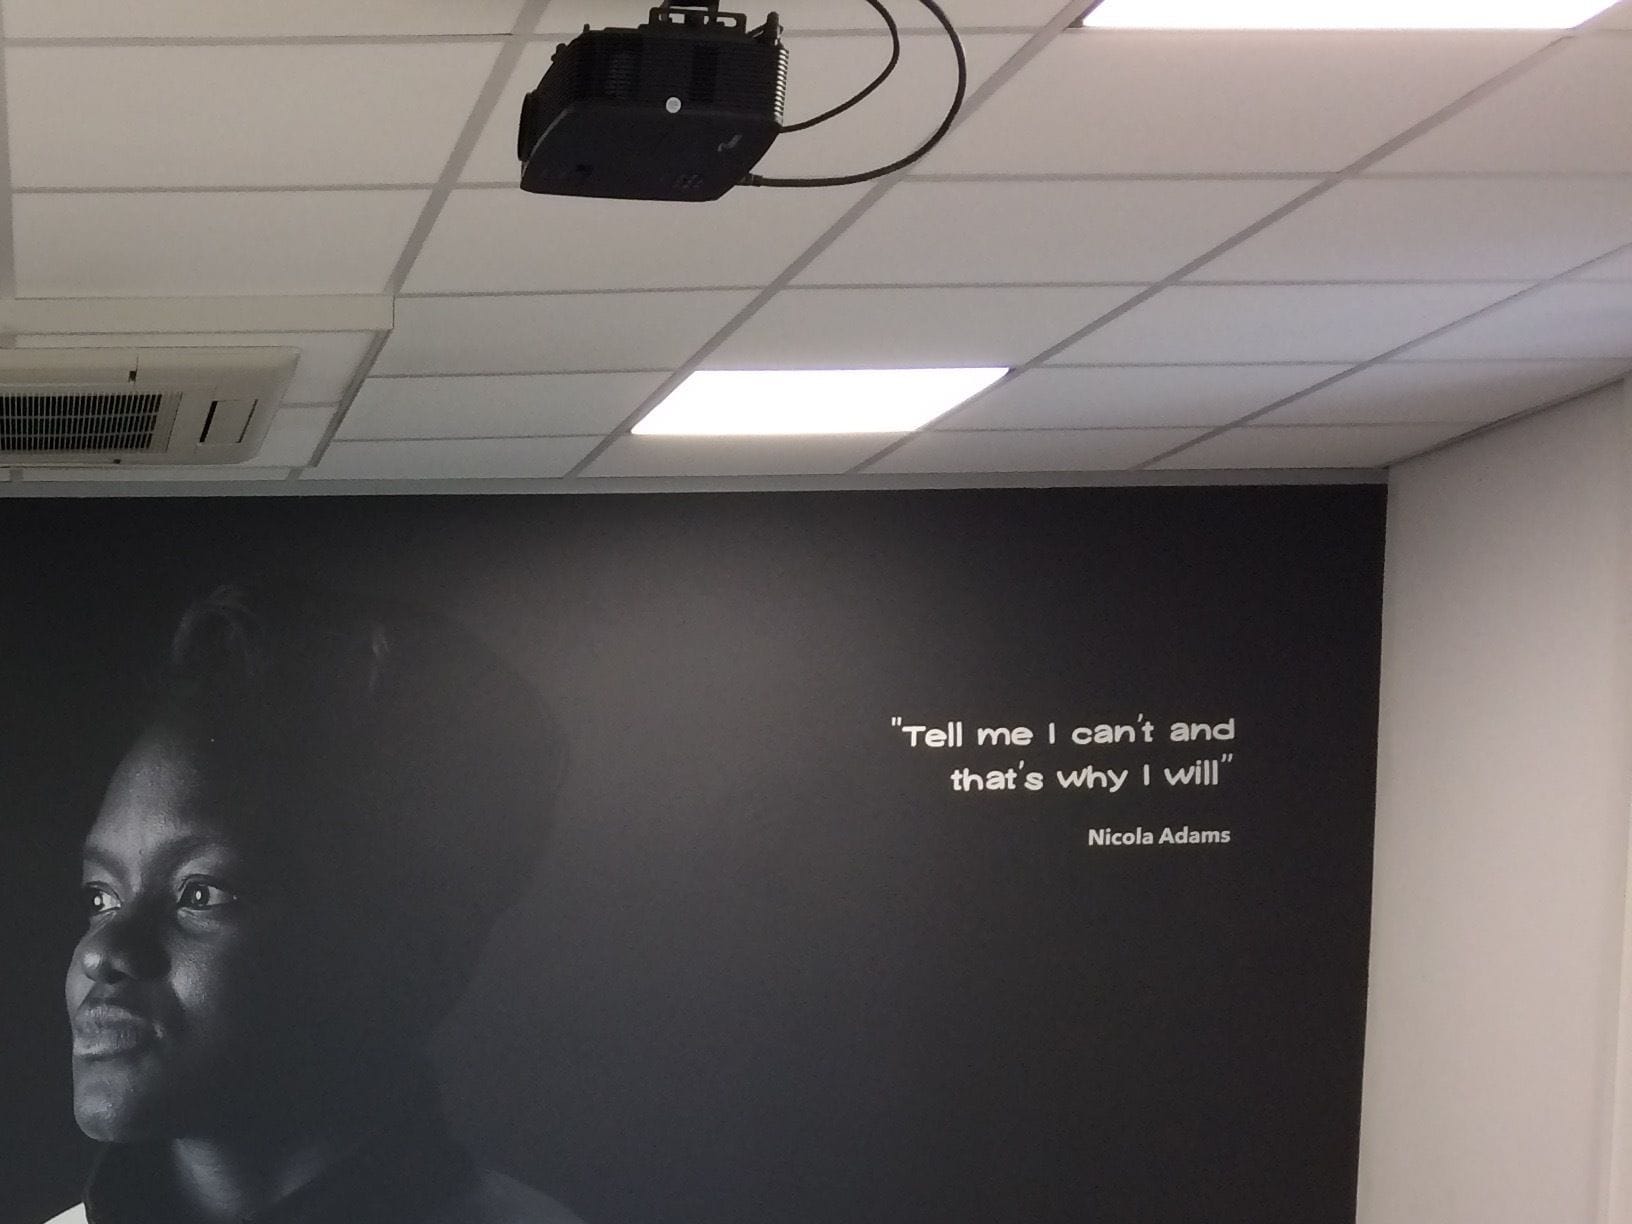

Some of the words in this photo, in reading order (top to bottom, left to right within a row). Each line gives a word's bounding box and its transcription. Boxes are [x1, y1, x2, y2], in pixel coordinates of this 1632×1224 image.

[891, 716, 963, 748] "Tell
[977, 726, 1034, 746] me
[1048, 722, 1056, 745] I
[1071, 713, 1155, 745] can't
[1169, 717, 1236, 742] and
[950, 759, 1044, 792] that's
[1056, 764, 1129, 793] why
[1143, 763, 1150, 786] I
[1088, 826, 1154, 846] Nicola
[1158, 825, 1231, 845] Adams
